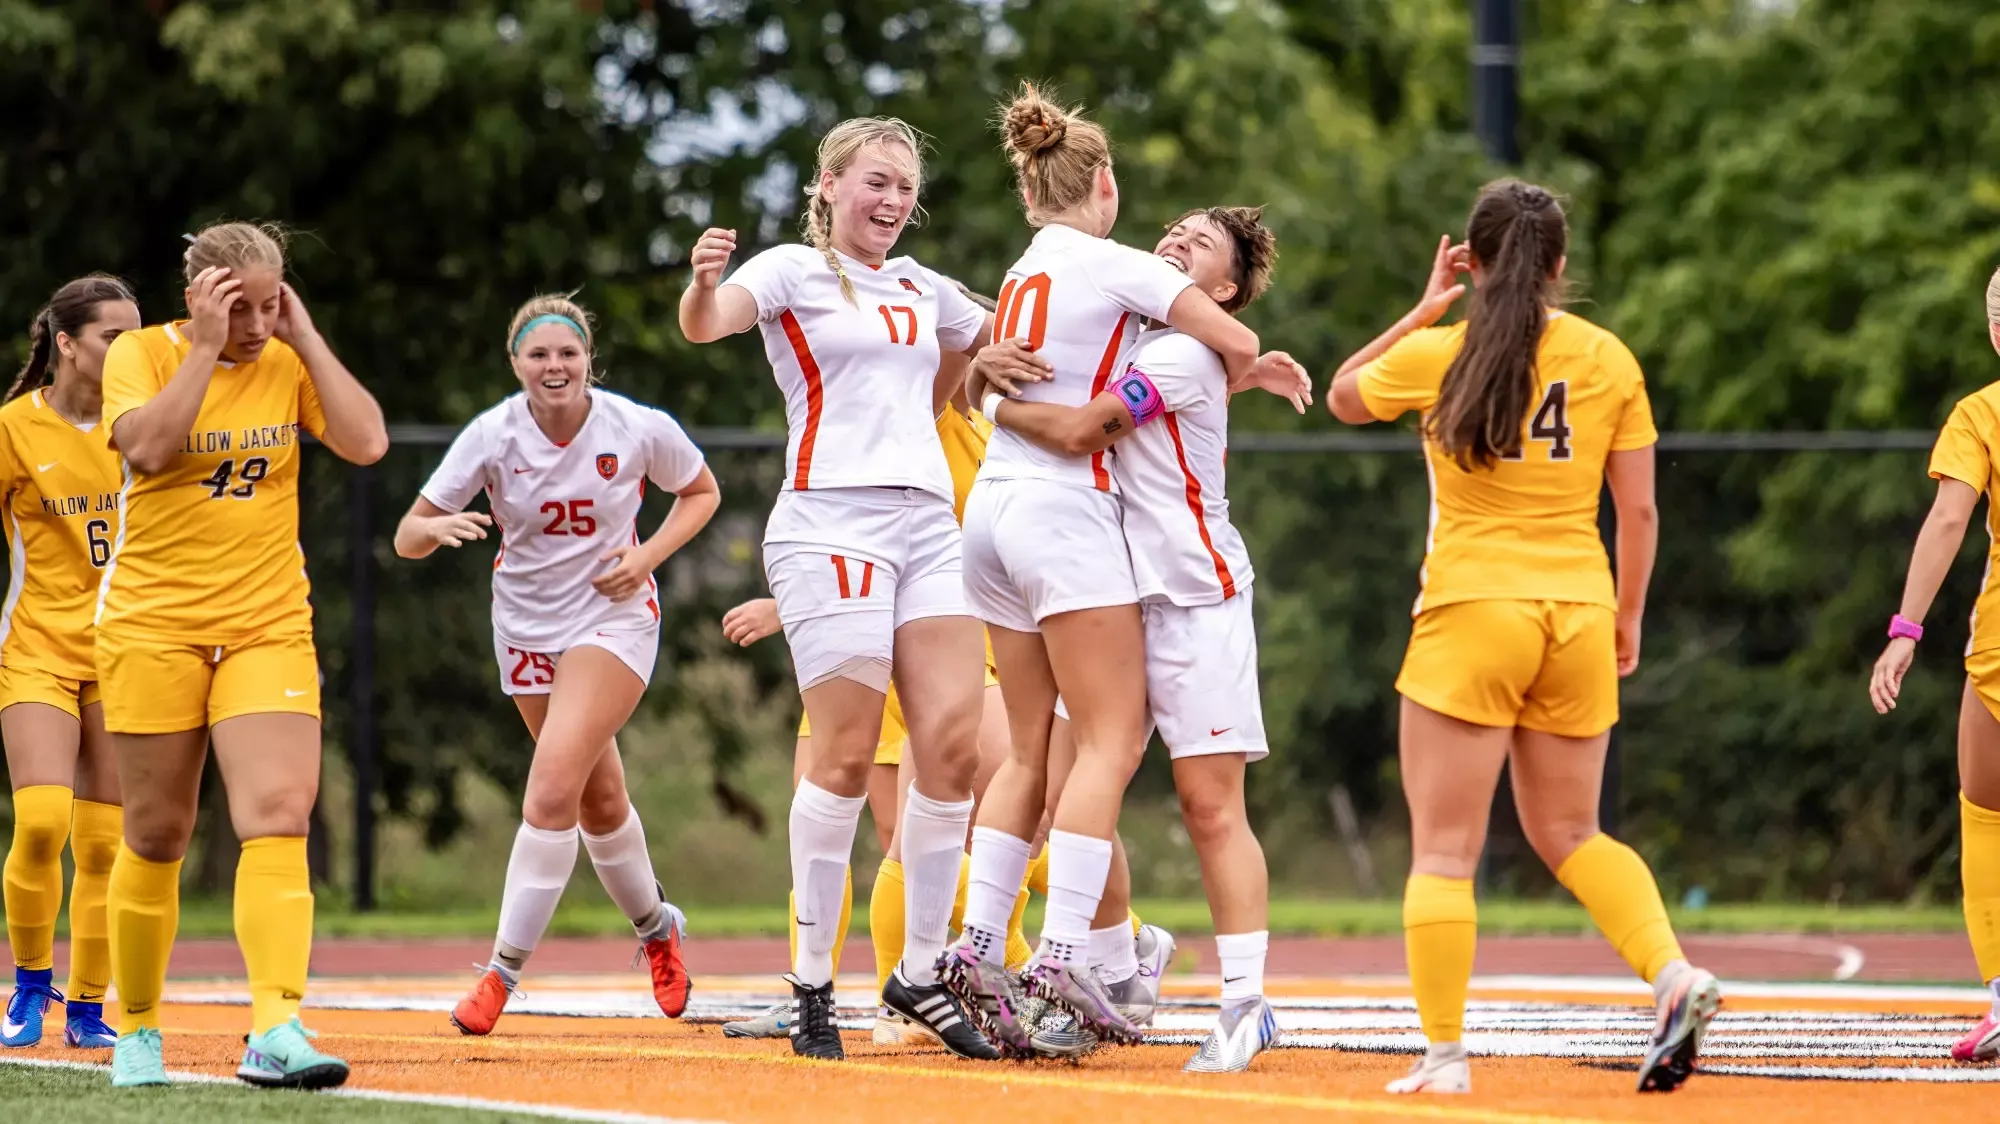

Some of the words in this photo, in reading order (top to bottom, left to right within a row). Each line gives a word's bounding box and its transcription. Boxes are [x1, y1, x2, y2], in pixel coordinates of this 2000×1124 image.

[877, 304, 918, 346] 17
[993, 271, 1052, 353] 10
[1121, 379, 1149, 403] C
[1500, 380, 1573, 461] 4
[178, 431, 231, 453] LLOW
[199, 457, 269, 500] 49
[540, 499, 597, 538] 25
[86, 519, 111, 569] 6
[831, 554, 875, 599] 17
[508, 646, 556, 687] 25
